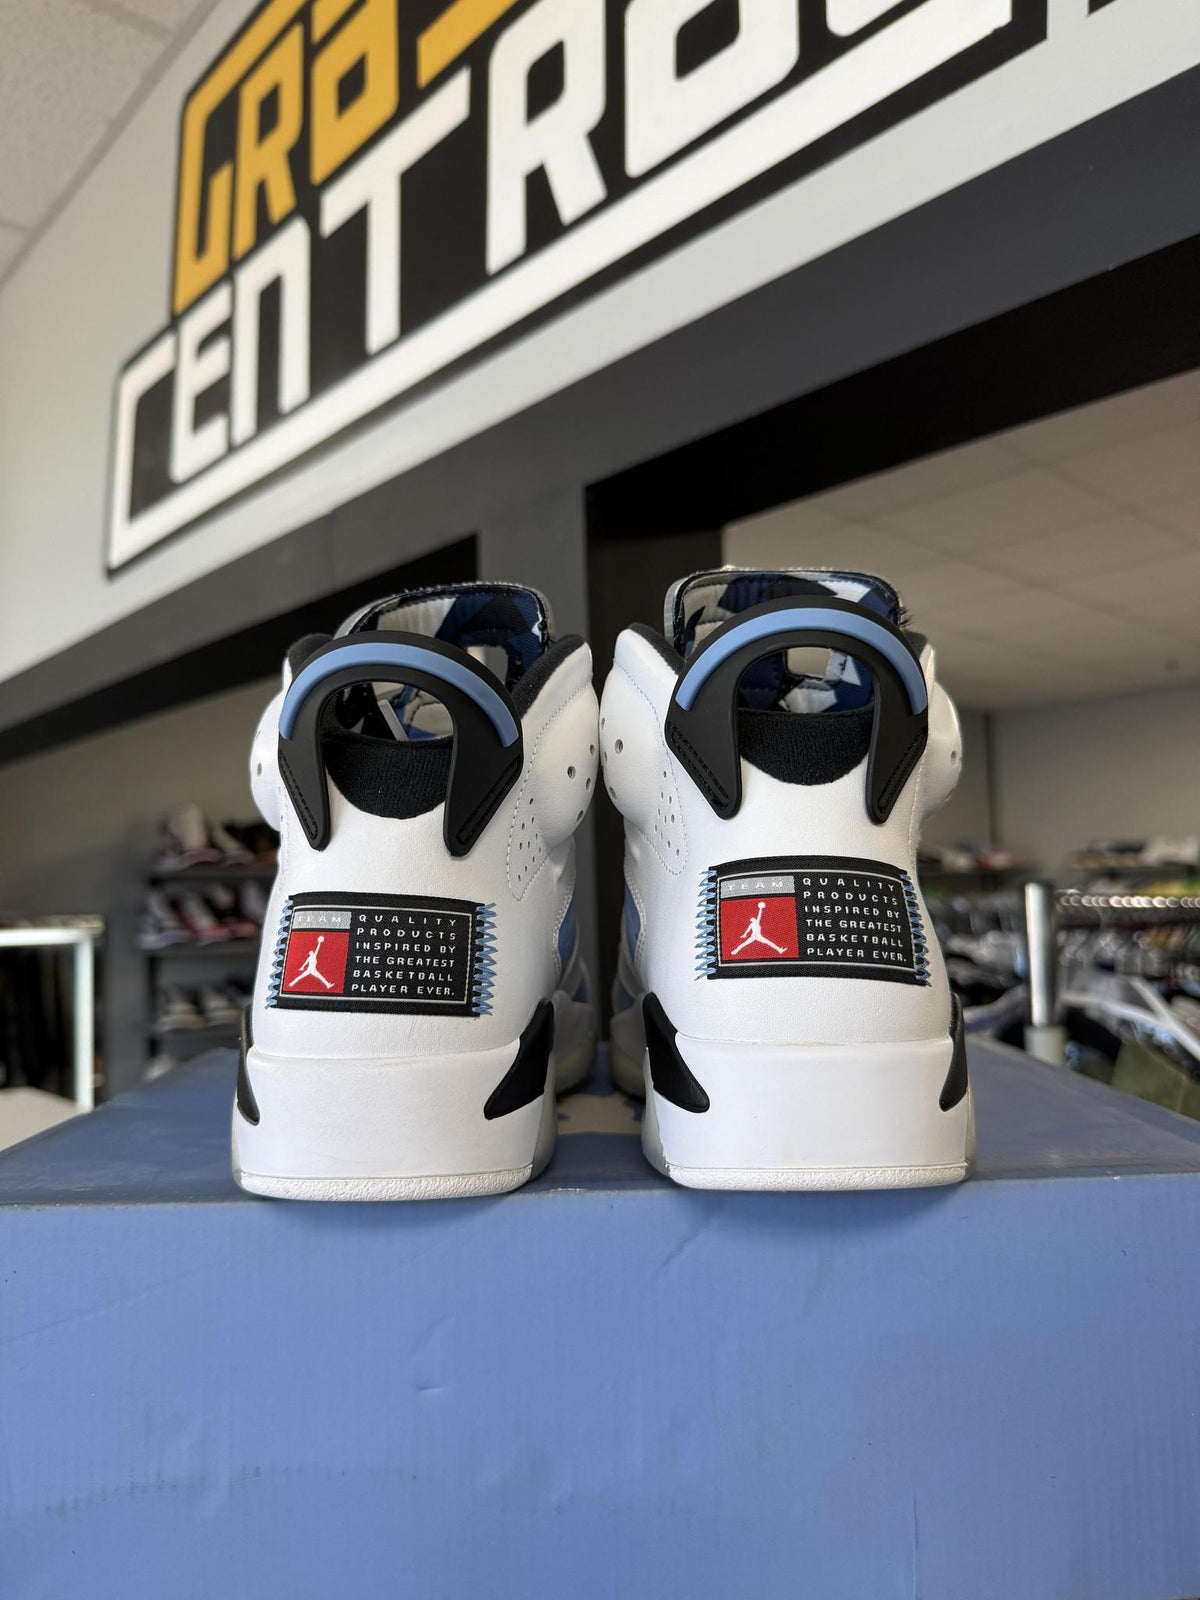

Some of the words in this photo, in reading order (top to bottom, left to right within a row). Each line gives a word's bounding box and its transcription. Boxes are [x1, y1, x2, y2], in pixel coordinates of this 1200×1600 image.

[727, 880, 784, 891] TEAM
[802, 877, 895, 892] QUALITY
[803, 891, 898, 906] PRODUCTS
[804, 905, 880, 916] INSPIRED
[887, 910, 900, 919] BY
[297, 915, 342, 923] TEAM
[359, 914, 456, 927] QUALITY
[806, 919, 833, 928] THE
[839, 920, 902, 933] GREATEST
[356, 928, 456, 940] PRODUCTS
[806, 933, 903, 947] BASKETBALL
[356, 942, 431, 952] INSPIRED
[439, 945, 456, 954] BY
[807, 948, 865, 958] PLAYER
[873, 950, 907, 962] EVER.
[354, 956, 380, 965] THE
[386, 956, 455, 968] GREATEST
[353, 970, 453, 981] BASKETBALL
[352, 984, 408, 994] PLAYER
[417, 985, 455, 996] EVER.
